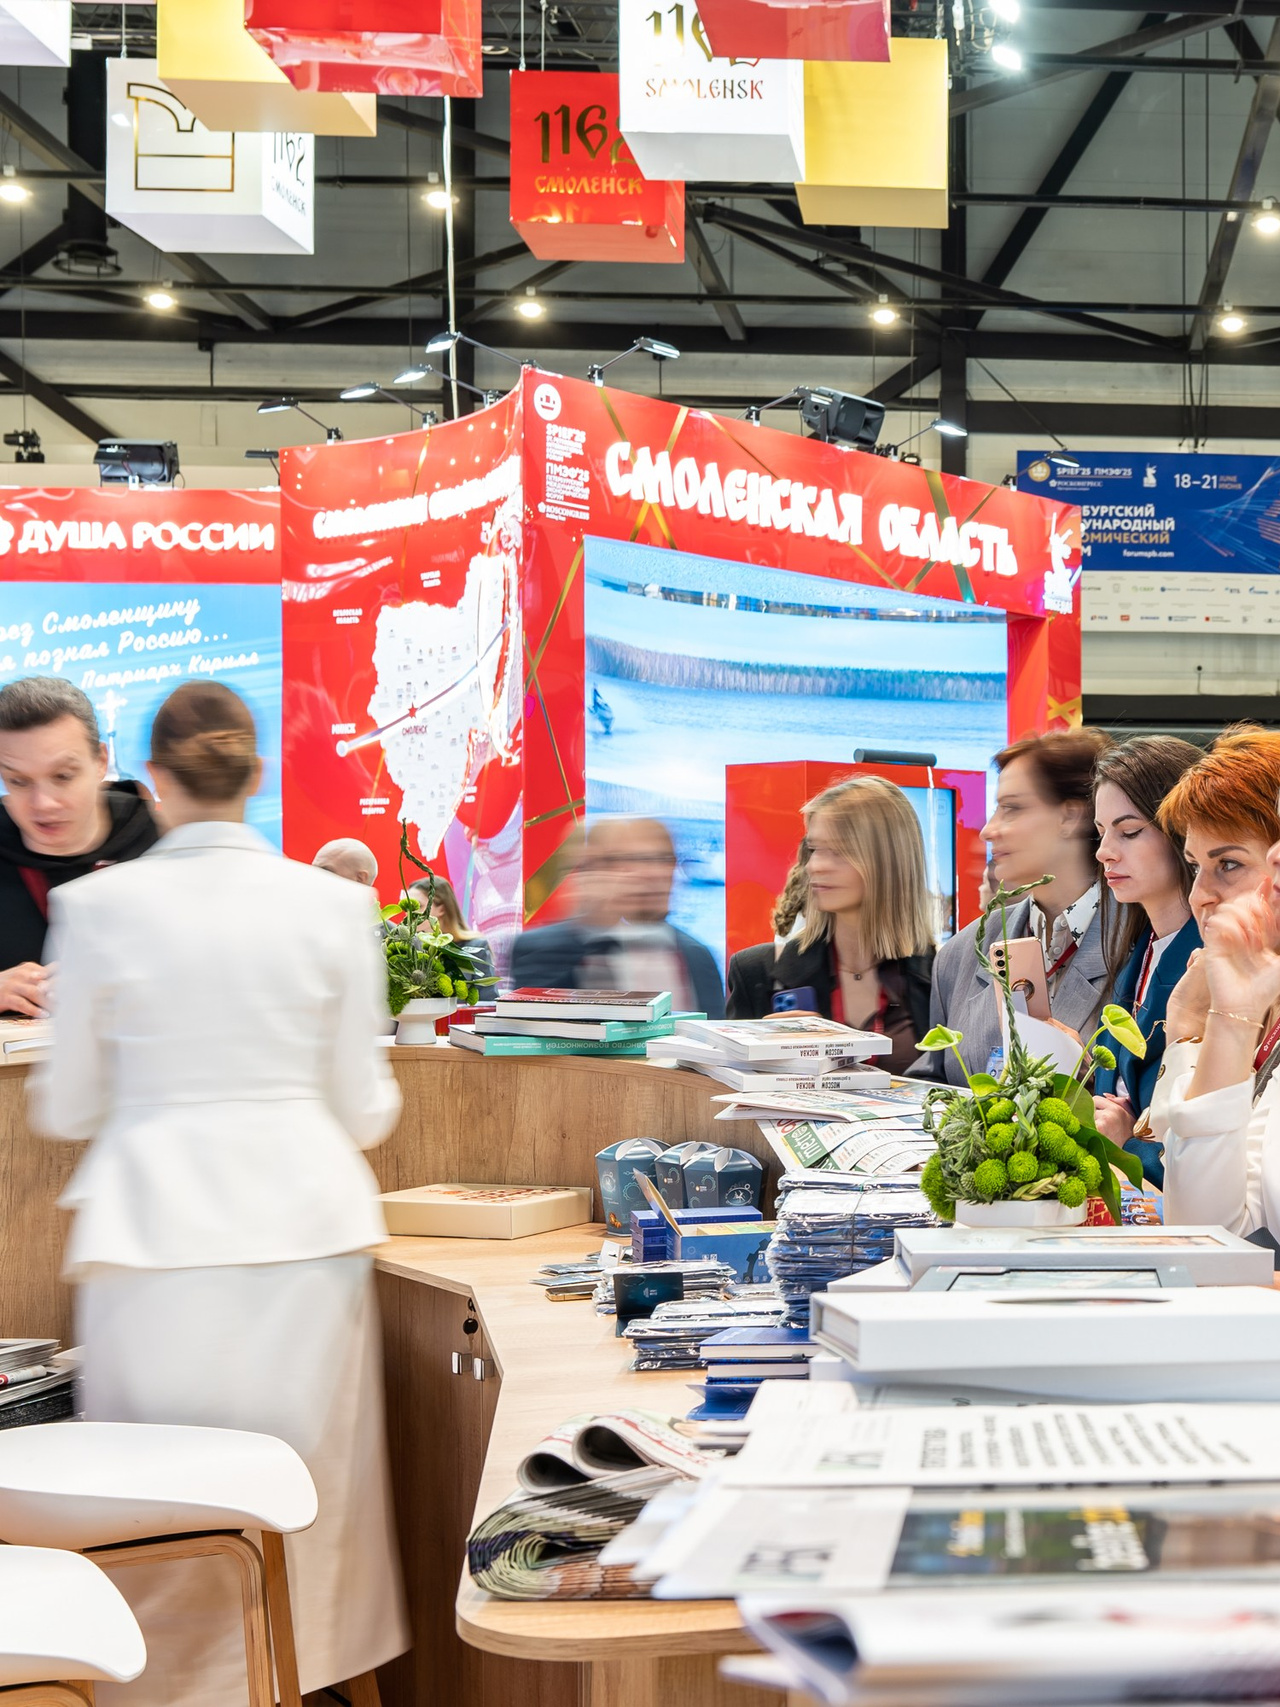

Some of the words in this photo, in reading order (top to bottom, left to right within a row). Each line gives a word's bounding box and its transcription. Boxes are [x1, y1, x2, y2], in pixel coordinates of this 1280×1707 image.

[534, 175, 644, 195] СМОЛЕНСК
[604, 441, 863, 545] СМОЛЕНСКАЯ
[878, 502, 1018, 576] ОБЛАСТЬ
[17, 520, 127, 554] ДУША
[132, 521, 275, 551] РОССИИ
[800, 1049, 819, 1057] МОСКВА
[796, 1082, 815, 1090] МОСКВА
[821, 1081, 841, 1089] MOSCOW
